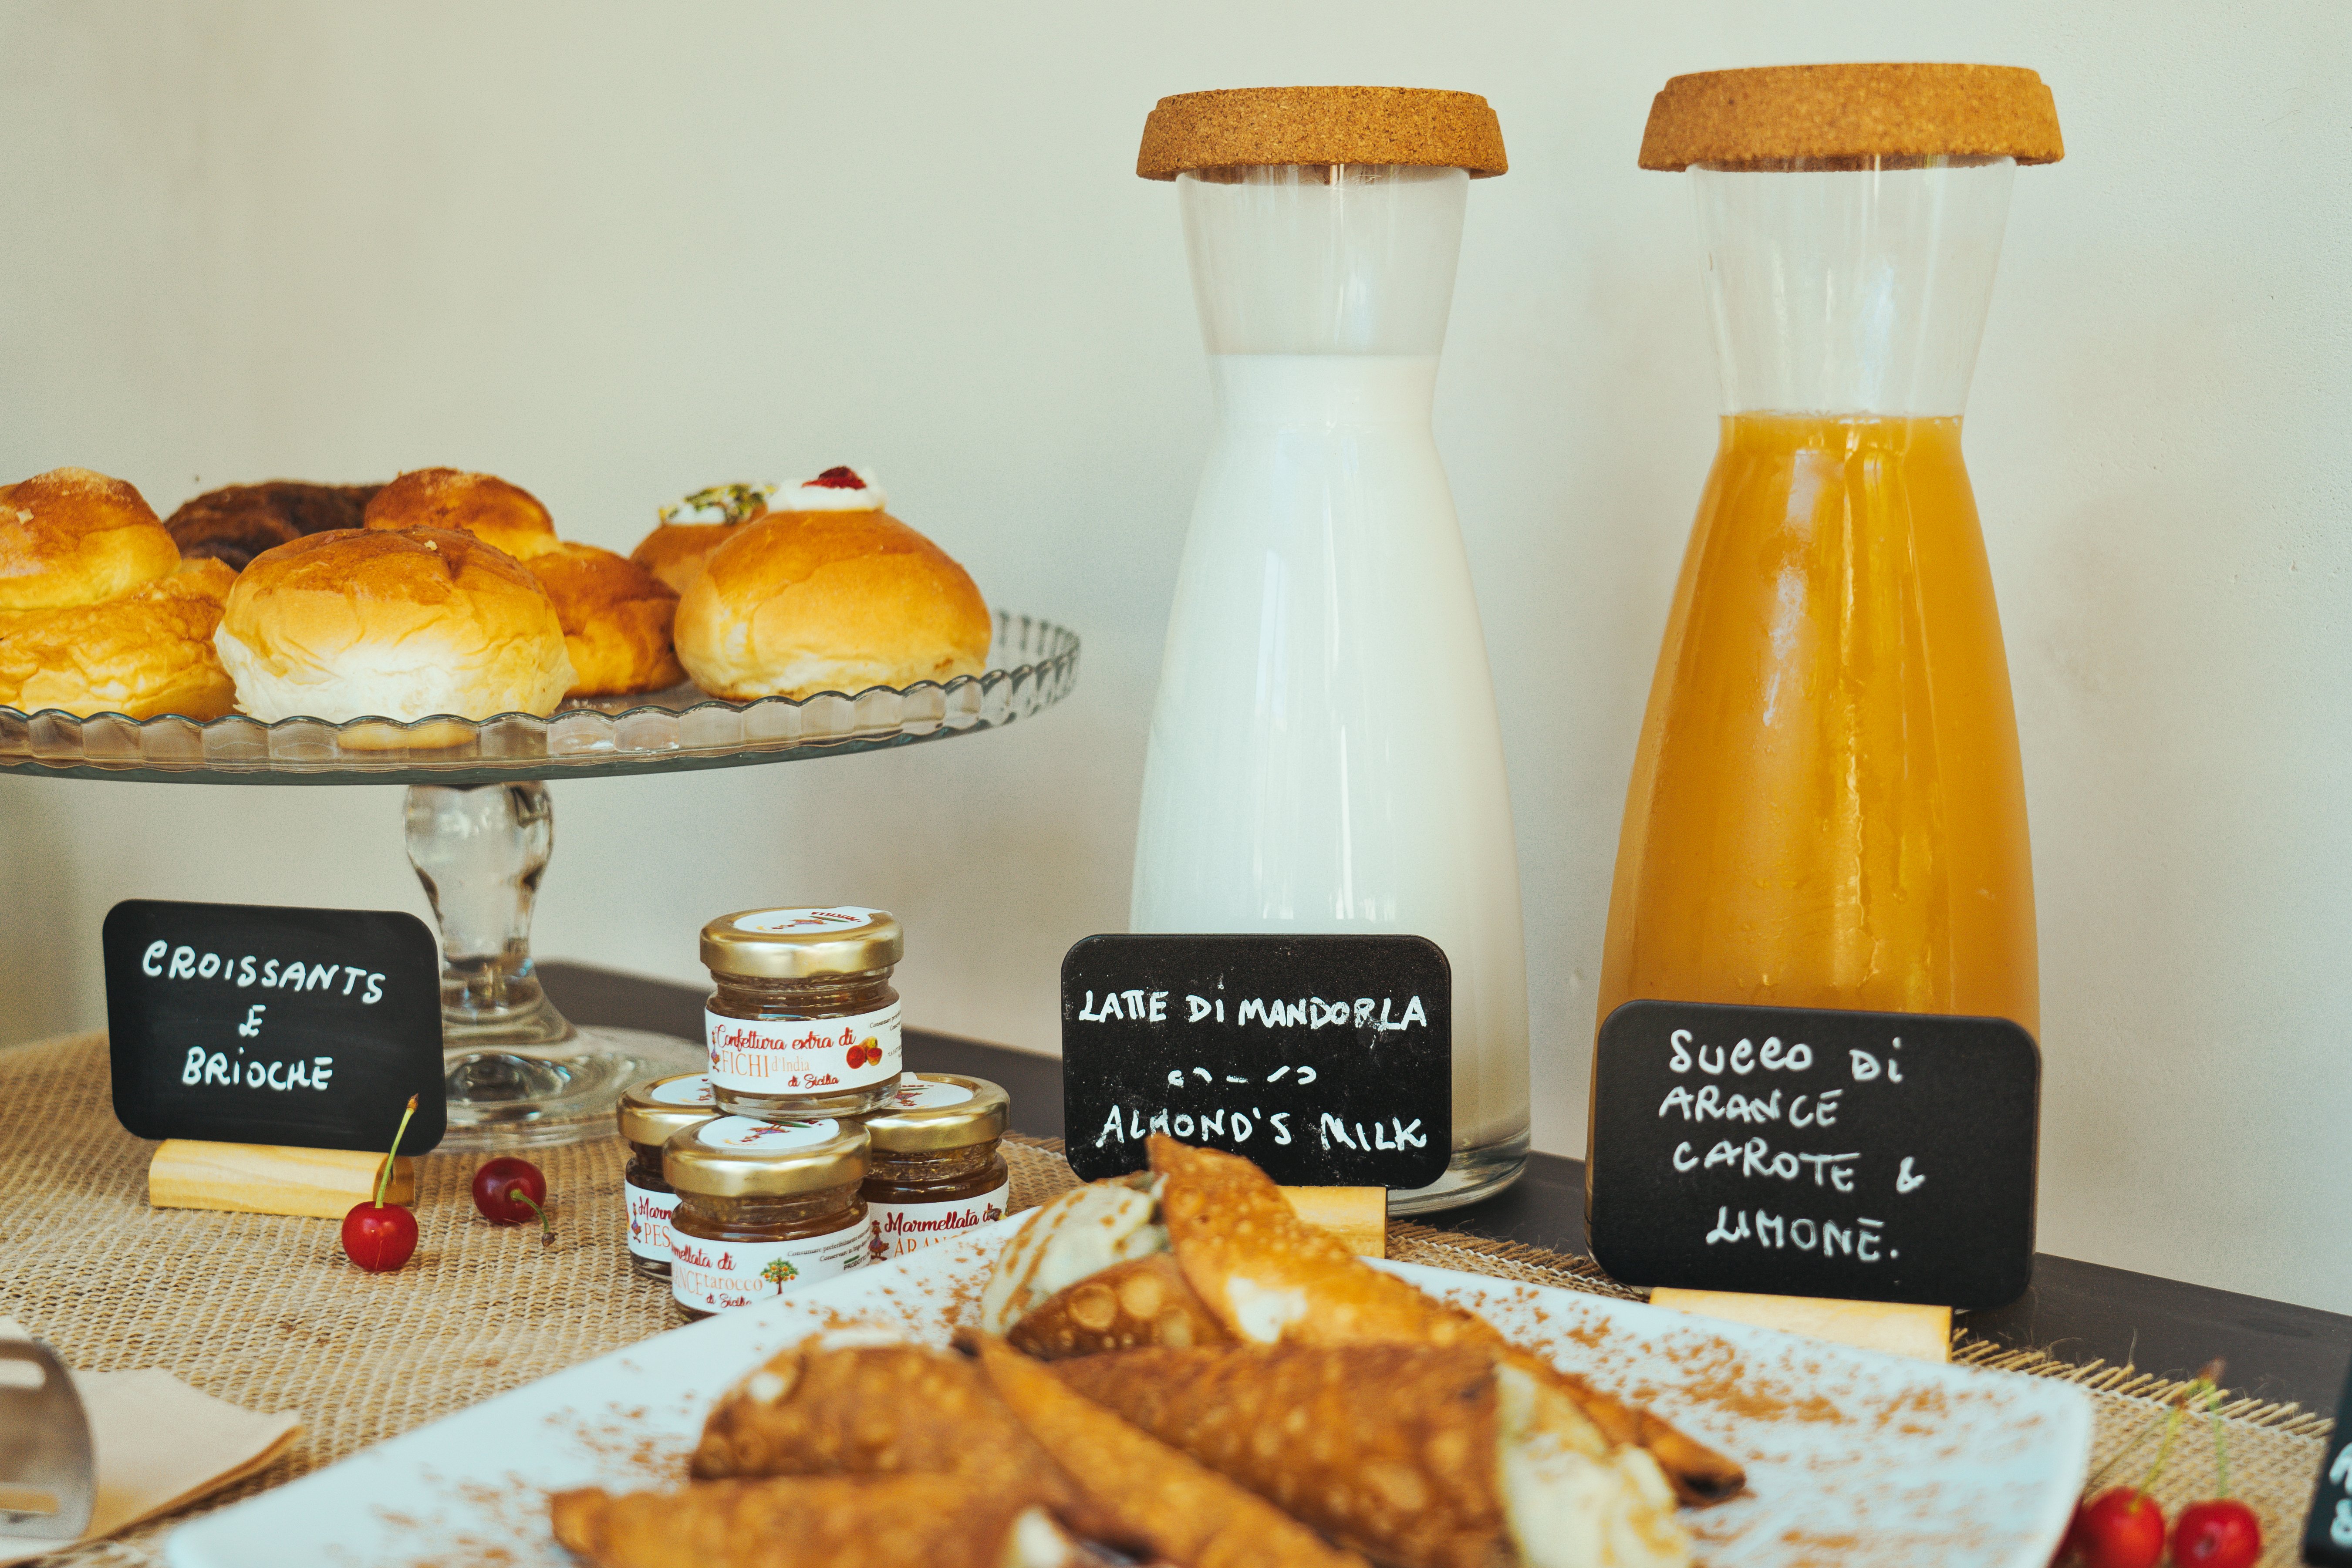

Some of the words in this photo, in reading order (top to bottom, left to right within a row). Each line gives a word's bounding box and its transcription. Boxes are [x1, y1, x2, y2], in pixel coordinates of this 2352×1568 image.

[142, 940, 386, 1004] CROISSANTS
[1079, 989, 1169, 1023] LATTE
[1238, 995, 1427, 1030] MANDORLA
[715, 1024, 786, 1052] Confettura
[793, 1030, 834, 1050] extra
[838, 1027, 856, 1045] di
[722, 1050, 769, 1077] FICHI
[788, 1075, 800, 1087] di
[803, 1073, 839, 1089] Sicilia
[1659, 1085, 1842, 1128] ARANCE
[1095, 1105, 1292, 1148] ALMOND'S
[1320, 1112, 1427, 1151] MILK
[1673, 1137, 1860, 1192] CAROTE
[1896, 1156, 1926, 1194] &
[644, 1222, 671, 1248] PES
[884, 1209, 979, 1236] Marmellata
[718, 1251, 736, 1270] di
[704, 1272, 763, 1291] tarocco
[706, 1293, 716, 1304] di
